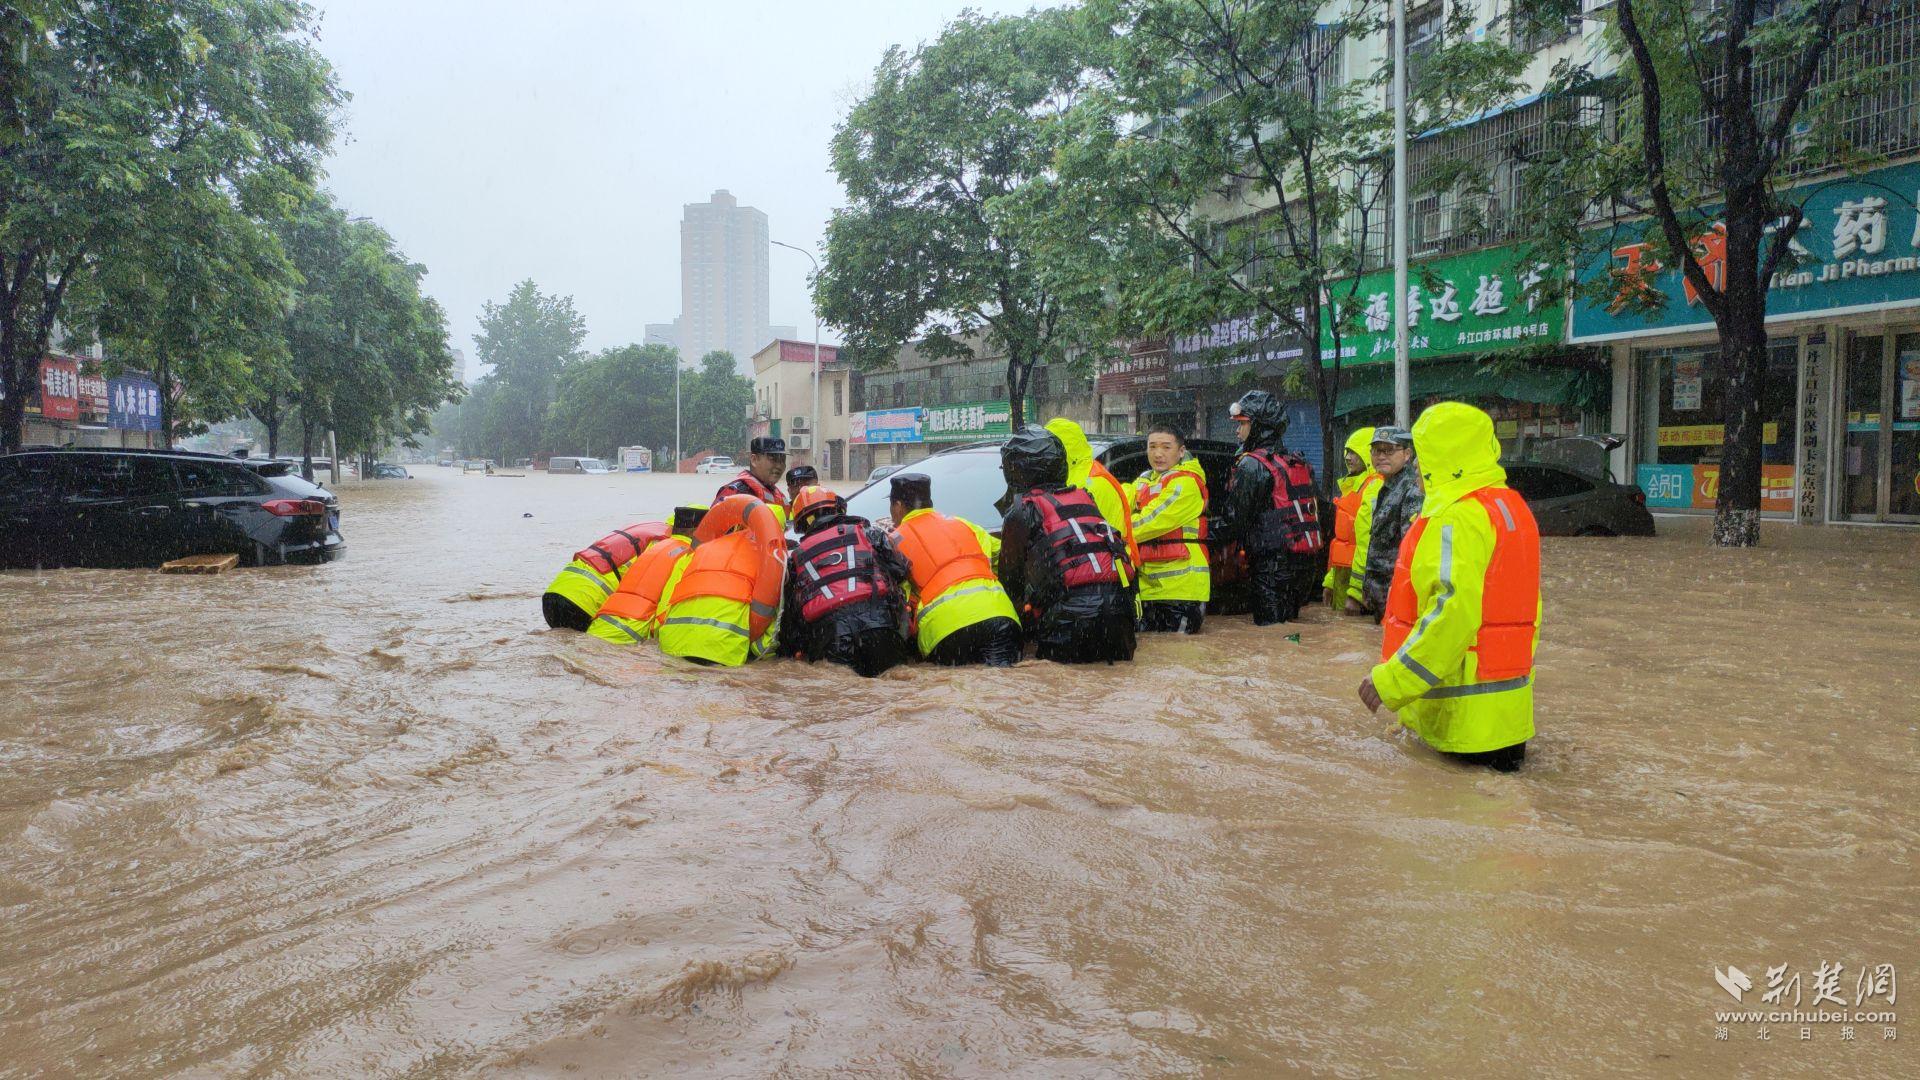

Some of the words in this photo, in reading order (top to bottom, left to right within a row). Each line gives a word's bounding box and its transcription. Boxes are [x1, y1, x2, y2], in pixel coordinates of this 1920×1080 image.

[1816, 263, 1840, 282] Ji
[1842, 256, 1920, 279] Pharm
[1457, 322, 1549, 345] 丹江口市环城路9号店
[1801, 350, 1819, 518] 丹江口市医保刷卡定点药店
[1647, 473, 1683, 499] 会员日
